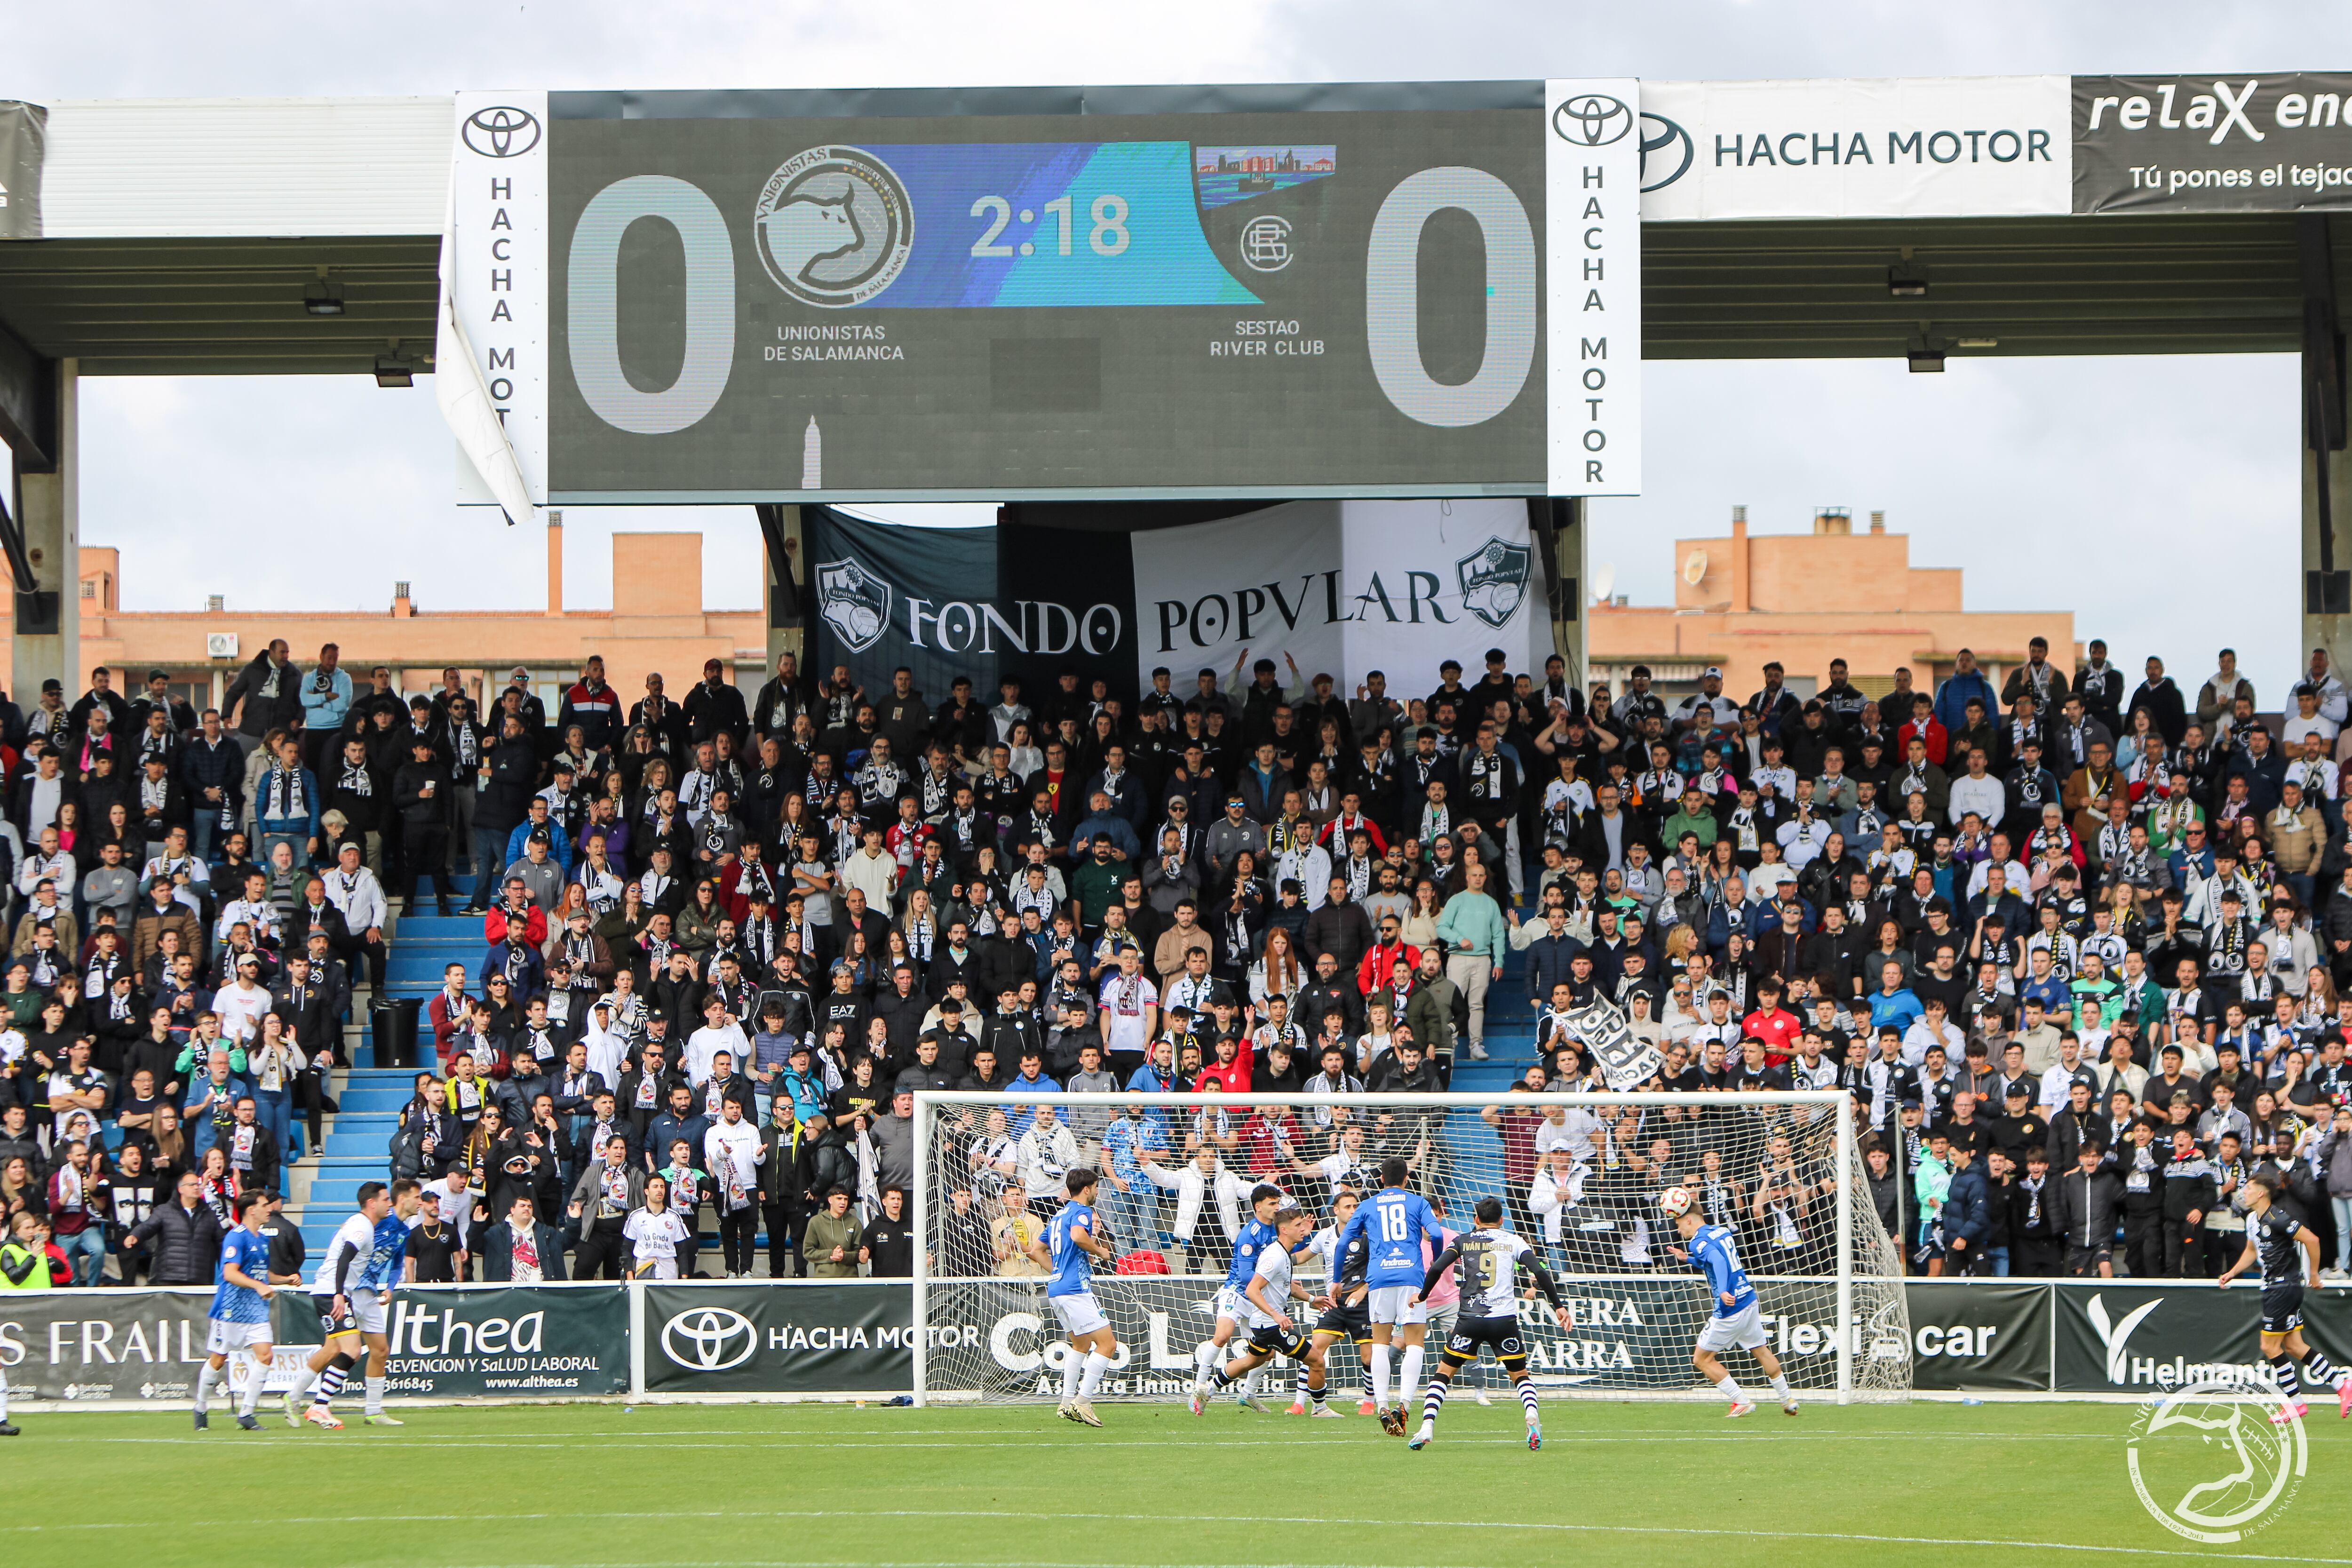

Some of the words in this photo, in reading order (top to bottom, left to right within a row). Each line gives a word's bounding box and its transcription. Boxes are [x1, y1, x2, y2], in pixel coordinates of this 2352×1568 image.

[1715, 131, 1874, 167] HACHA
[1889, 129, 2051, 165] MOTOR
[2129, 164, 2161, 189] Tú
[2169, 167, 2253, 195] pones
[2259, 163, 2283, 187] el
[969, 193, 1130, 258] 2:18
[1583, 165, 1605, 311] HACHA
[491, 177, 513, 322] HACHA
[568, 175, 735, 434] 0
[1366, 166, 1536, 427] 0
[777, 325, 885, 342] UNIONISTAS
[1235, 320, 1300, 336] SESTAO
[764, 346, 787, 361] DE
[791, 345, 905, 361] SALAMANCA
[1210, 341, 1267, 356] RIVER
[1274, 340, 1325, 356] CLUB
[489, 347, 515, 434] MOT
[1581, 337, 1607, 483] MOTOR
[905, 596, 1122, 655] FONDO
[830, 1005, 856, 1016] EA7
[1376, 1194, 1406, 1204] CÓRDOBA
[1376, 1203, 1408, 1242] 18
[1462, 1241, 1481, 1252] IVÁN
[1482, 1242, 1513, 1253] MORENO
[1719, 1236, 1743, 1273] 12
[1479, 1252, 1497, 1287] 9
[382, 1299, 544, 1356] lthea
[1516, 1297, 1643, 1326] RNERA
[49, 1319, 208, 1365] FRAIL
[769, 1327, 870, 1350] HACHA
[1525, 1339, 1636, 1369] ARRA
[1915, 1324, 1997, 1357] car
[384, 1359, 466, 1374] REVENCION
[467, 1359, 477, 1373] Y
[531, 1357, 600, 1372] LABORAL
[382, 1377, 434, 1392] 3616845
[485, 1376, 580, 1388] www.althea.es
